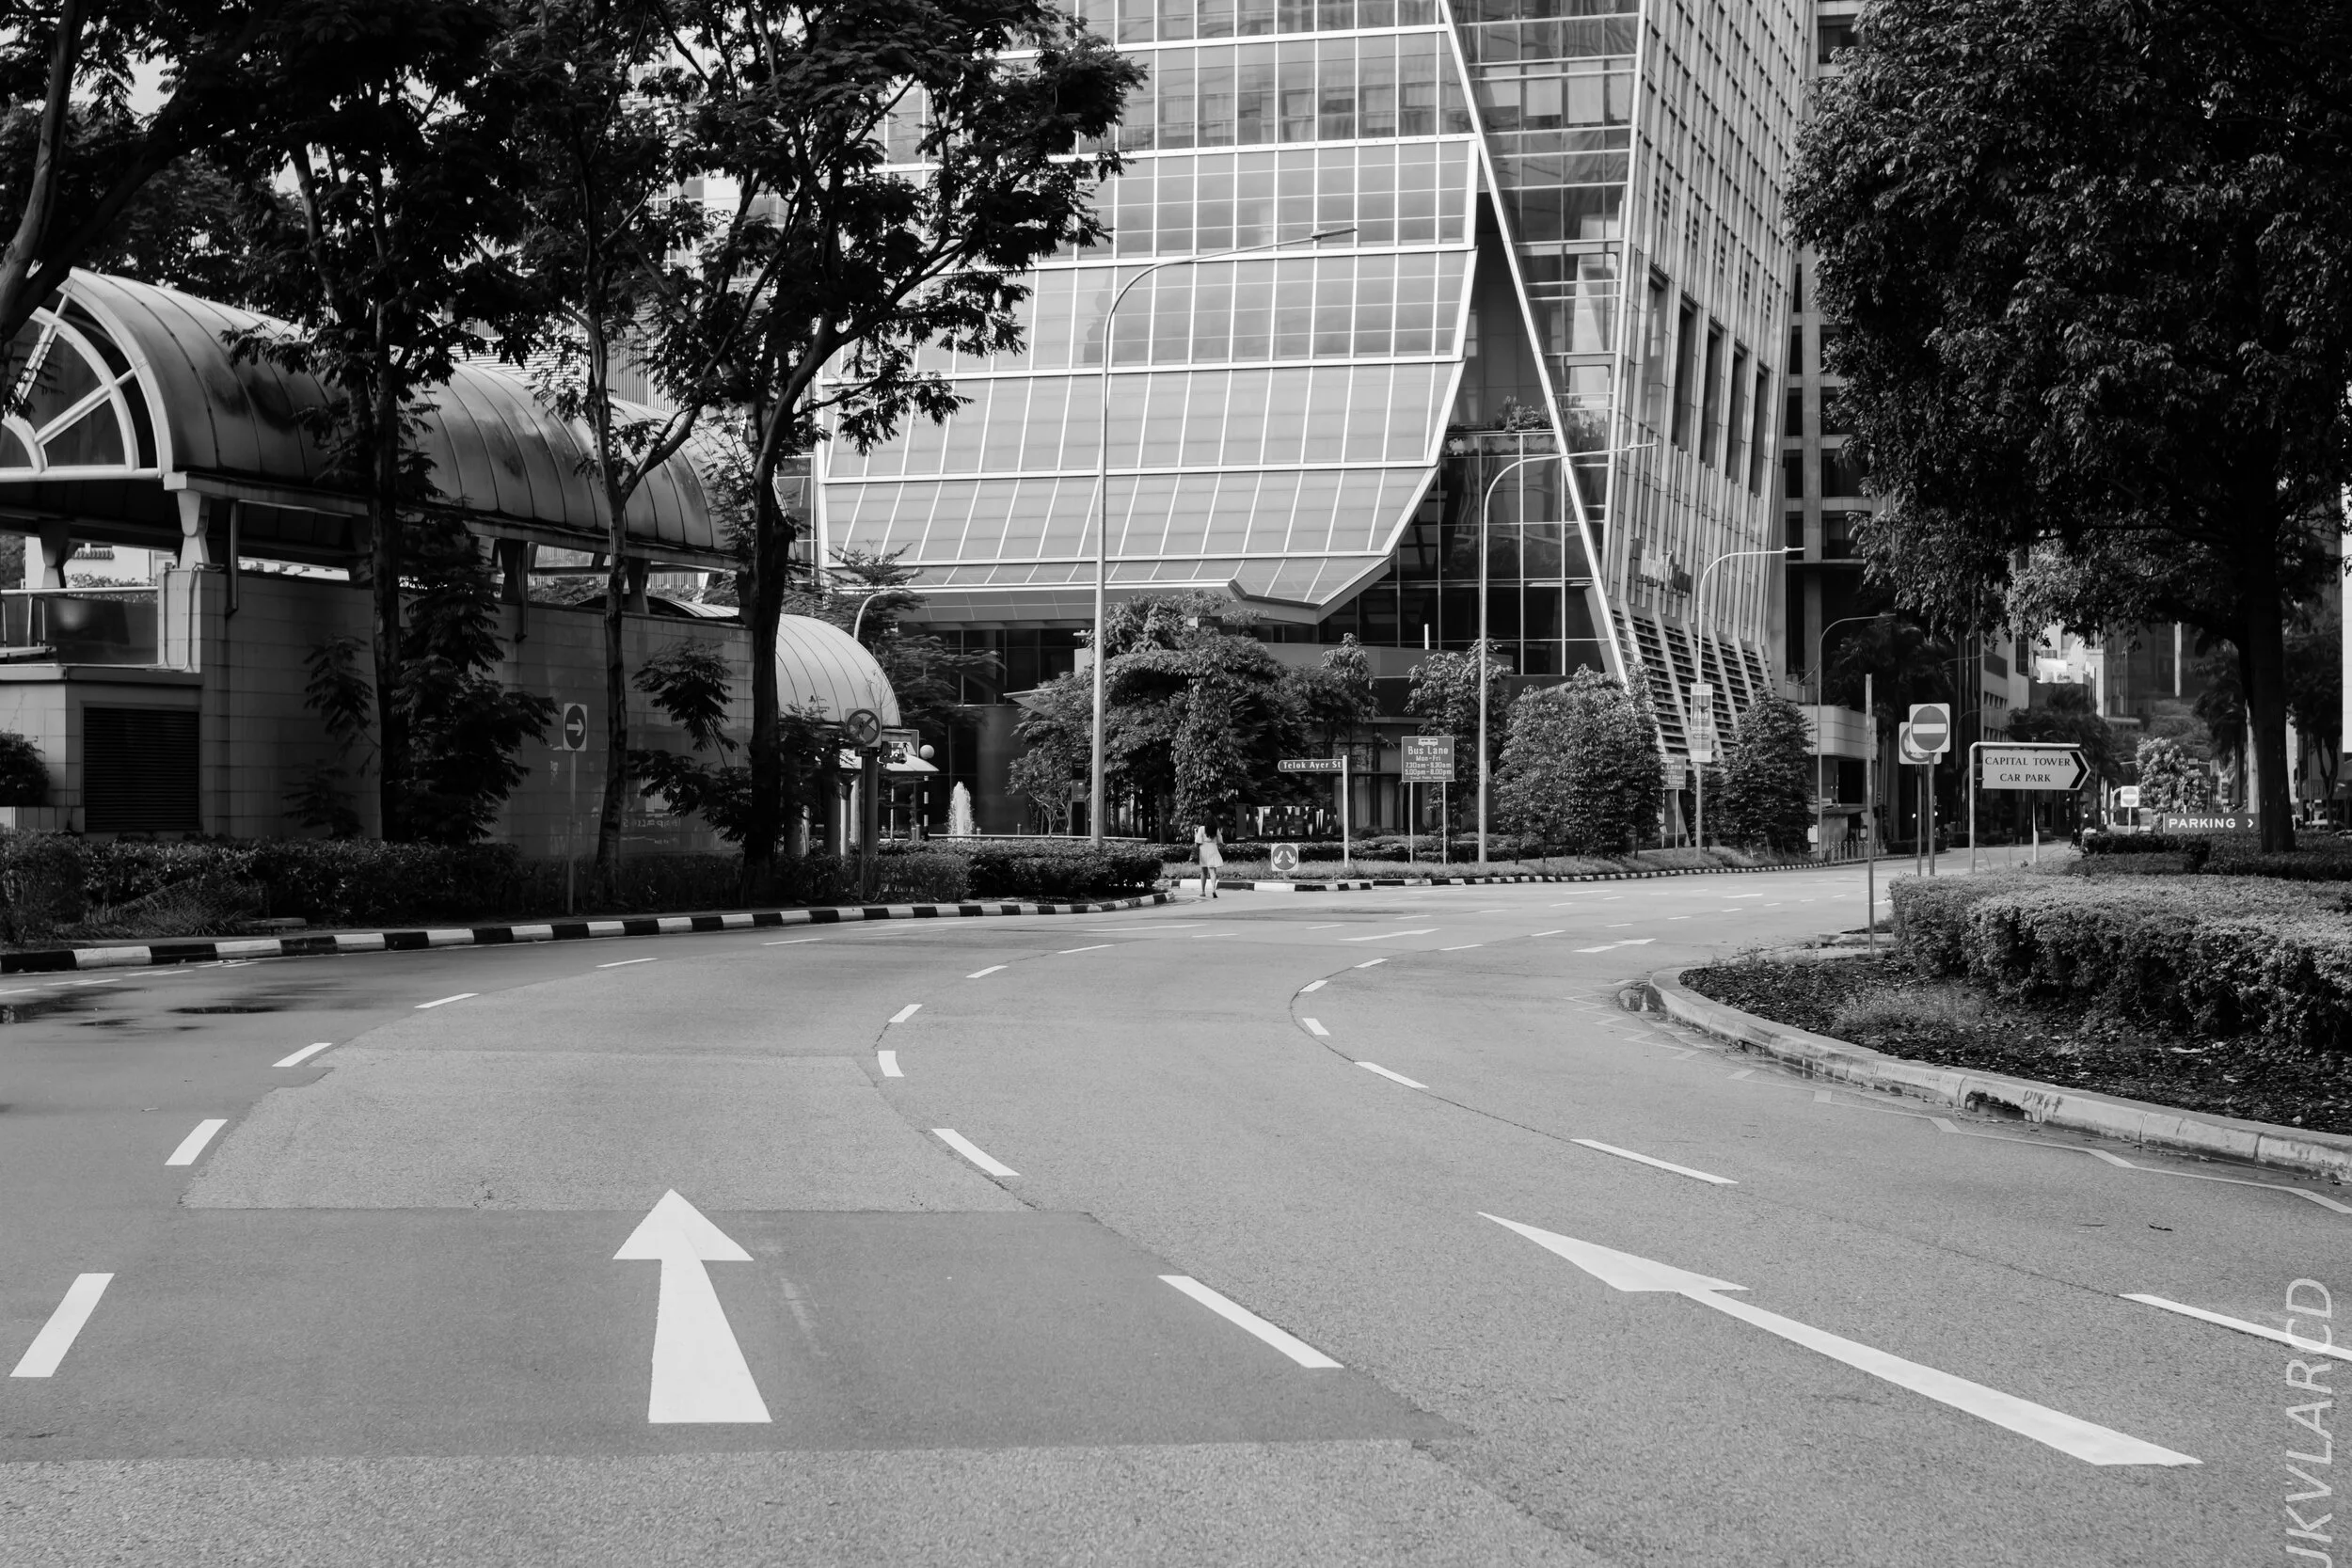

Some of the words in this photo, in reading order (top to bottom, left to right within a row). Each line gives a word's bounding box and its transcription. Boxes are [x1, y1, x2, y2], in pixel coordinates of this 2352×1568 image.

[1407, 745, 1424, 755] Bus
[1427, 745, 1449, 755] Lane
[1282, 761, 1306, 769] Telok
[1309, 761, 1329, 770] Ayer
[1331, 760, 1342, 768] St
[1984, 756, 2029, 766] CAPITAL
[2033, 757, 2071, 767] TOWER
[1999, 773, 2022, 782] CAR
[2025, 773, 2051, 783] PARK
[2169, 817, 2236, 829] PARKING
